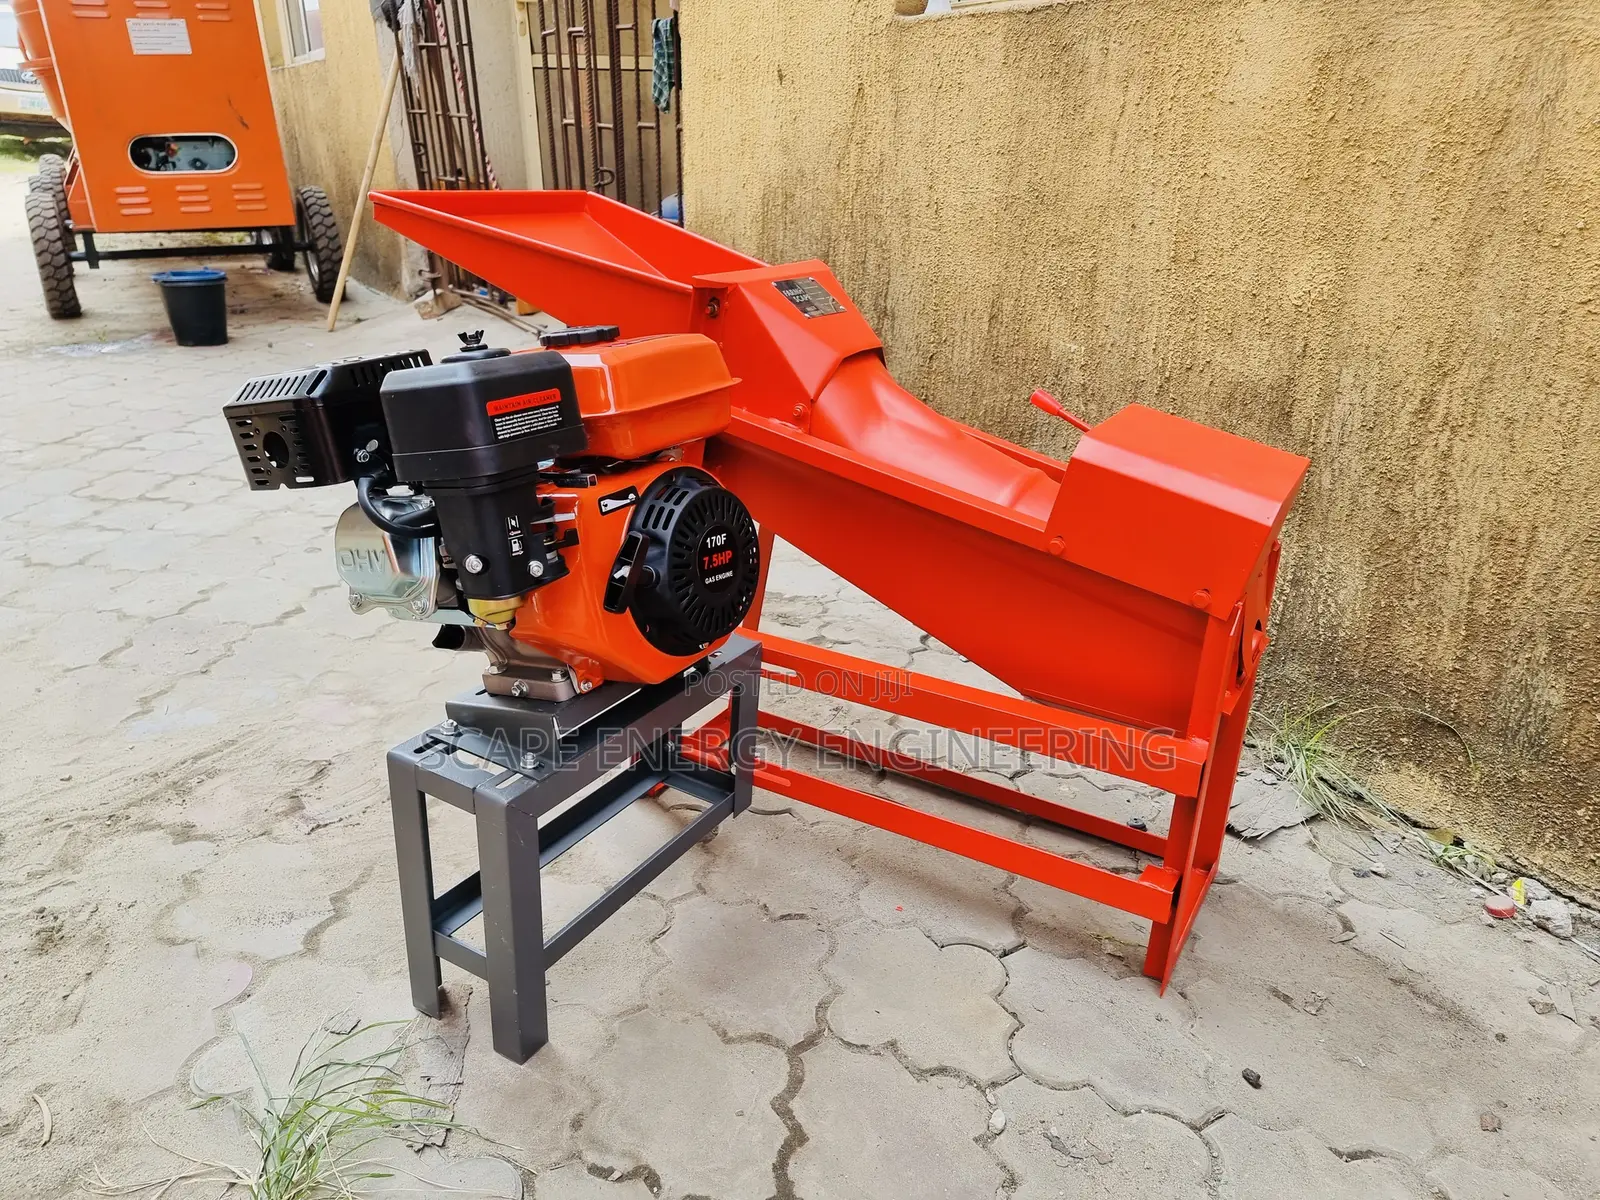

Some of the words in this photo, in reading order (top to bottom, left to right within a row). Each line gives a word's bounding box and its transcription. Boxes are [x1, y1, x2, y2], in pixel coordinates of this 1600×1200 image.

[494, 402, 521, 412] MAINTAIN
[522, 398, 532, 406] AIR
[533, 394, 557, 404] CLEANER
[706, 533, 727, 549] 170F
[339, 547, 386, 574] OHV
[703, 550, 733, 570] 7.5HP
[705, 576, 715, 584] GAS
[716, 570, 733, 581] ENGINE
